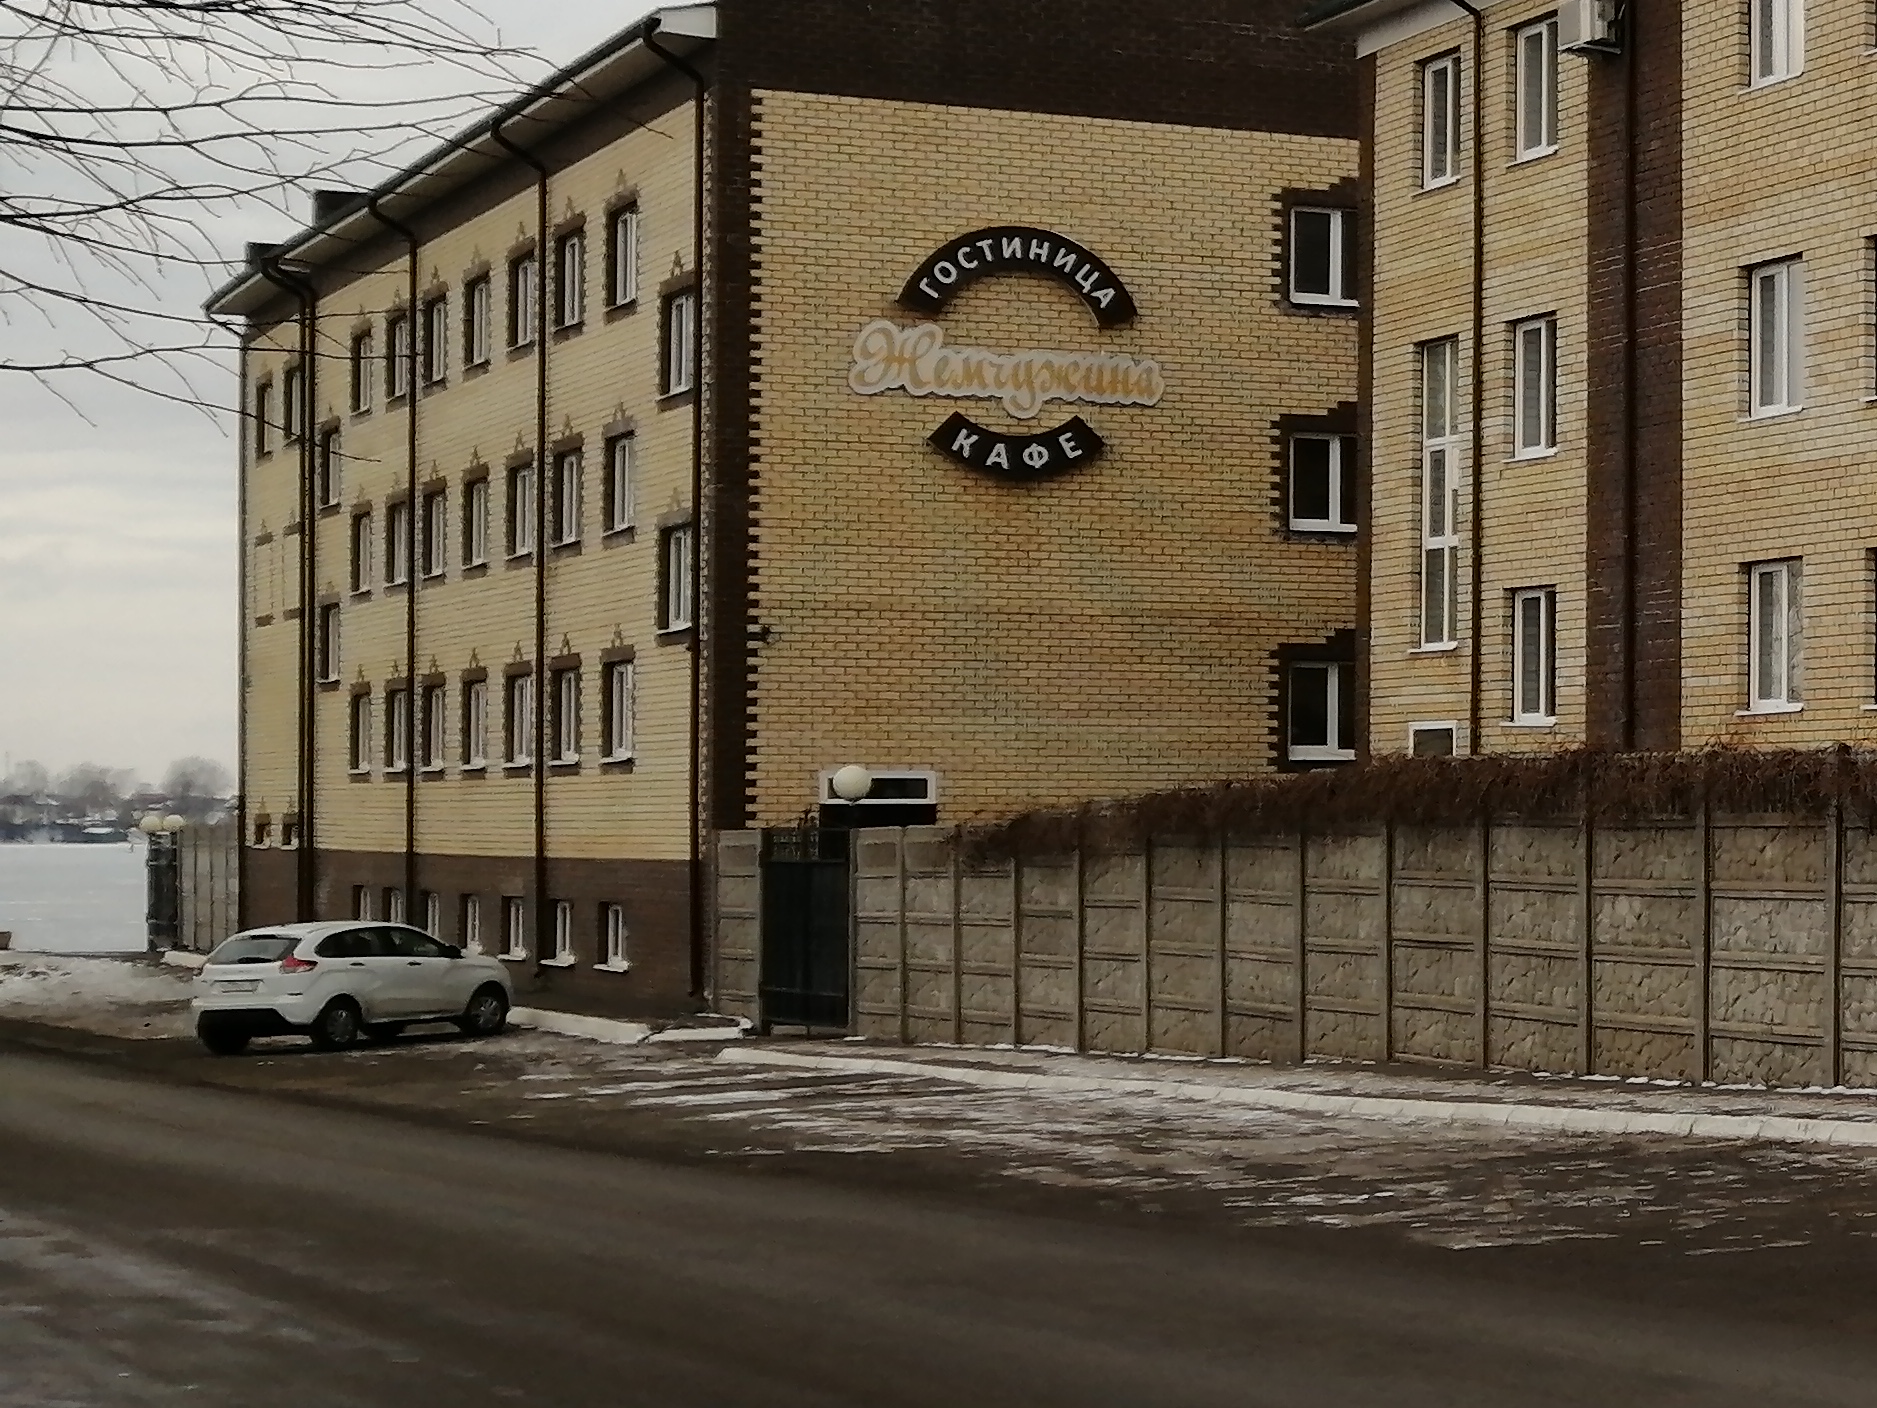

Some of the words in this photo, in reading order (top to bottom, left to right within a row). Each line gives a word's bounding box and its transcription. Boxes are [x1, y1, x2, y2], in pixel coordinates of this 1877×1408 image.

[918, 236, 1118, 310] ГОСТИНИЦА
[853, 326, 1162, 411] Жемчужина
[950, 428, 1083, 470] КАФЕ
